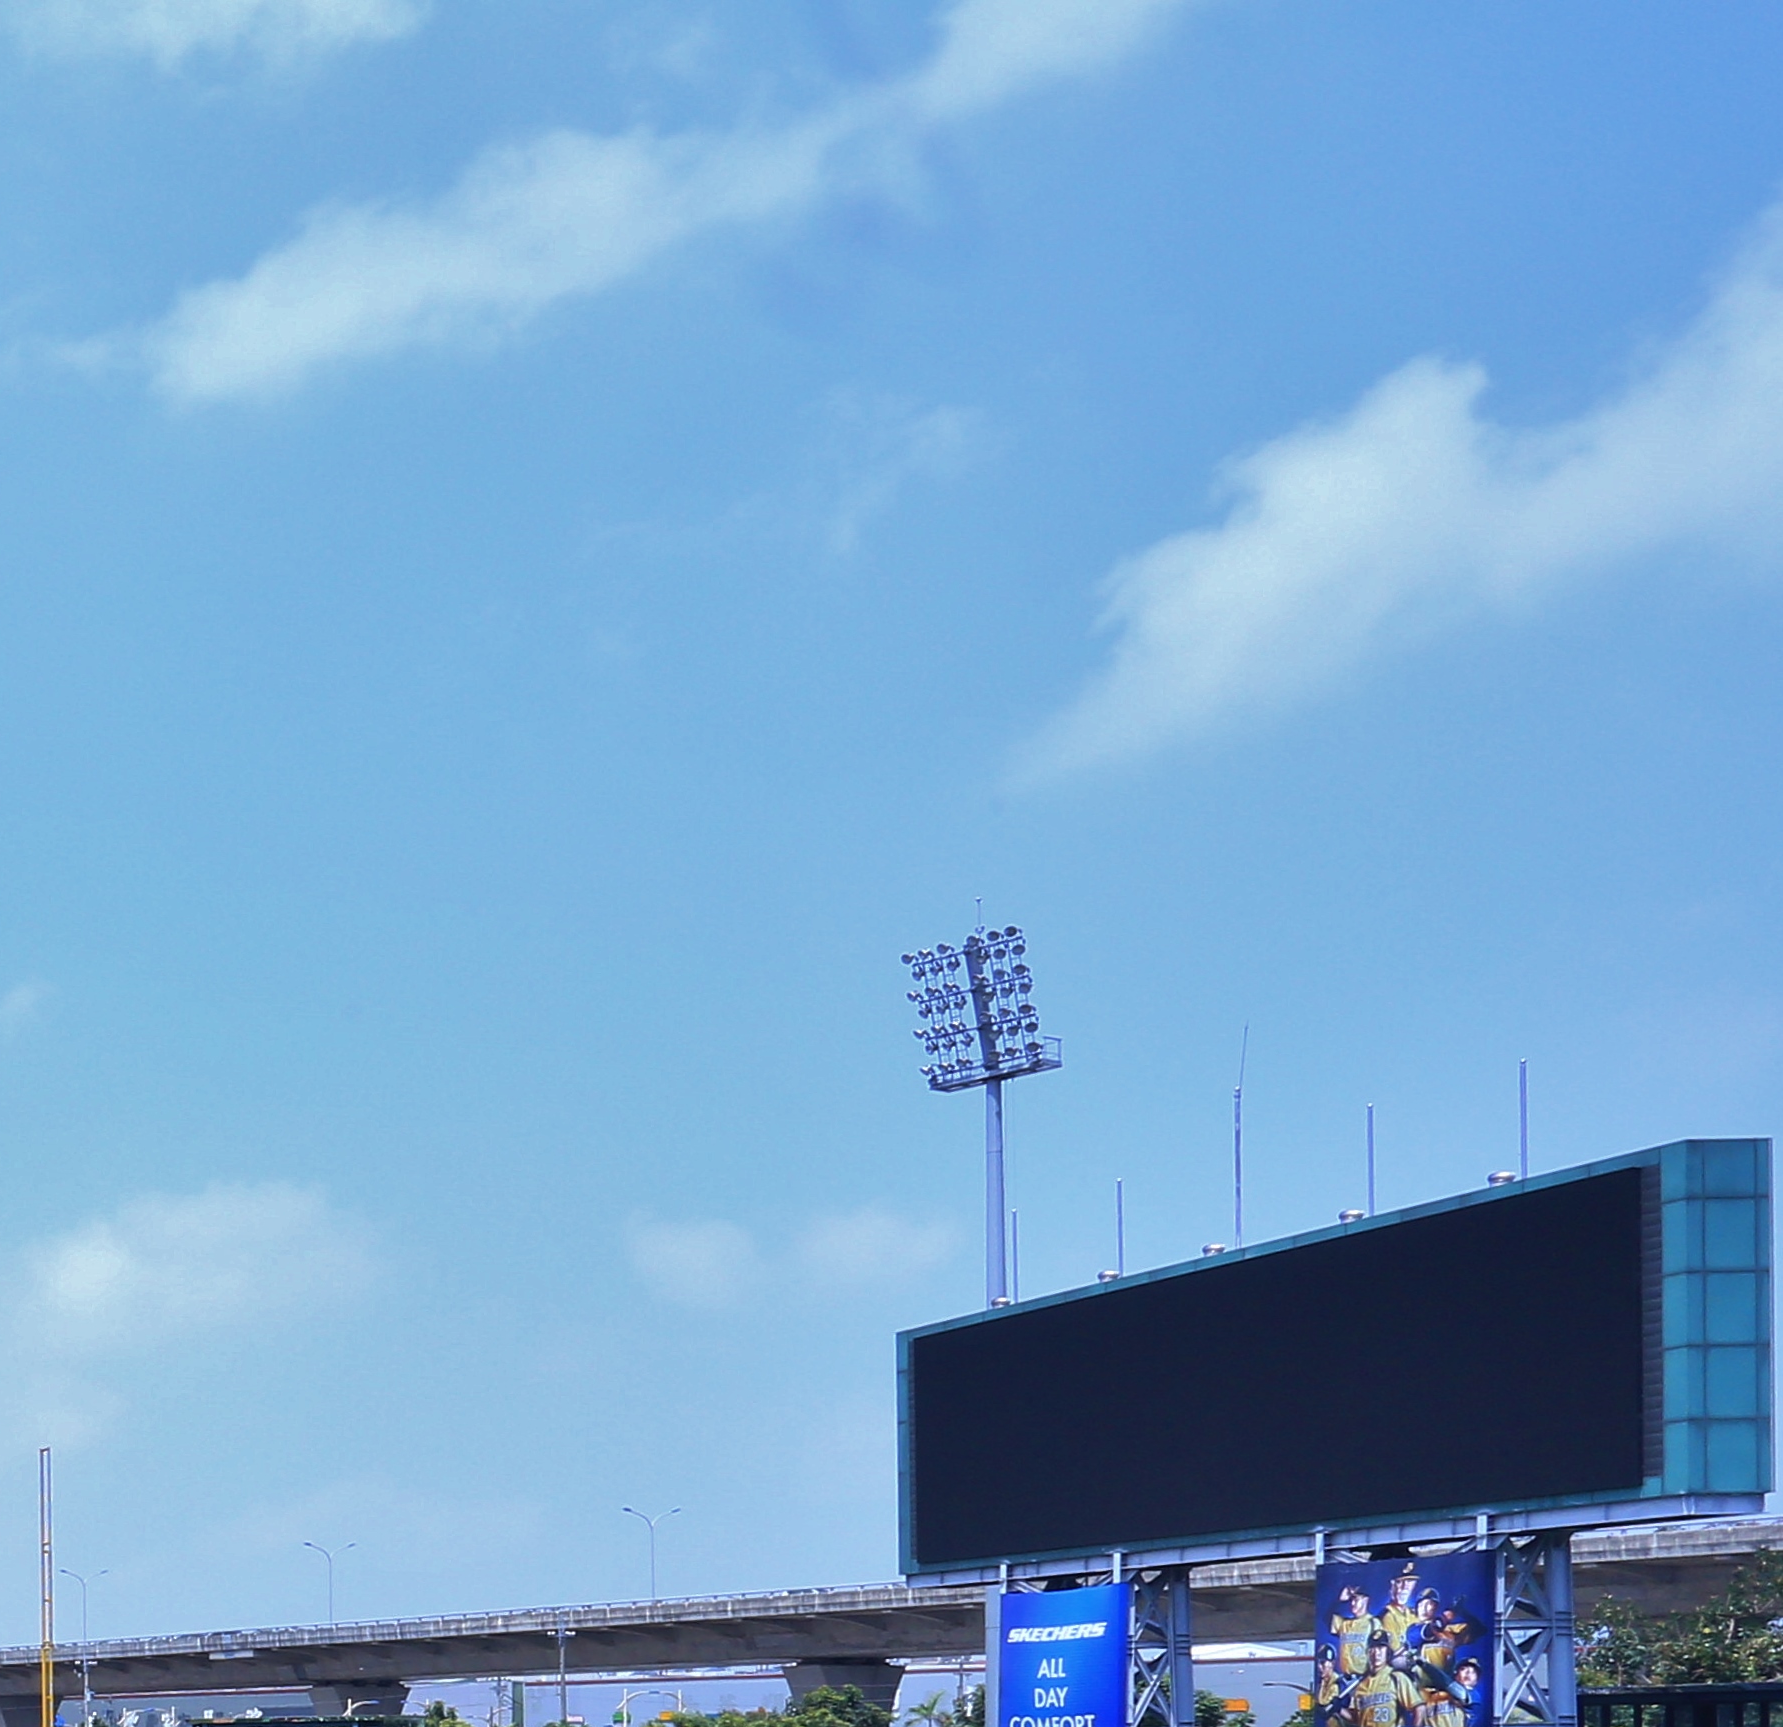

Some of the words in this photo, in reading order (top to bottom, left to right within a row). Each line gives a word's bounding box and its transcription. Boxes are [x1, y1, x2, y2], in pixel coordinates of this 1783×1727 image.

[1007, 1622, 1107, 1643] SKECHERS
[1037, 1657, 1066, 1679] ALL
[1034, 1686, 1068, 1708] DAY
[1373, 1707, 1390, 1723] 23
